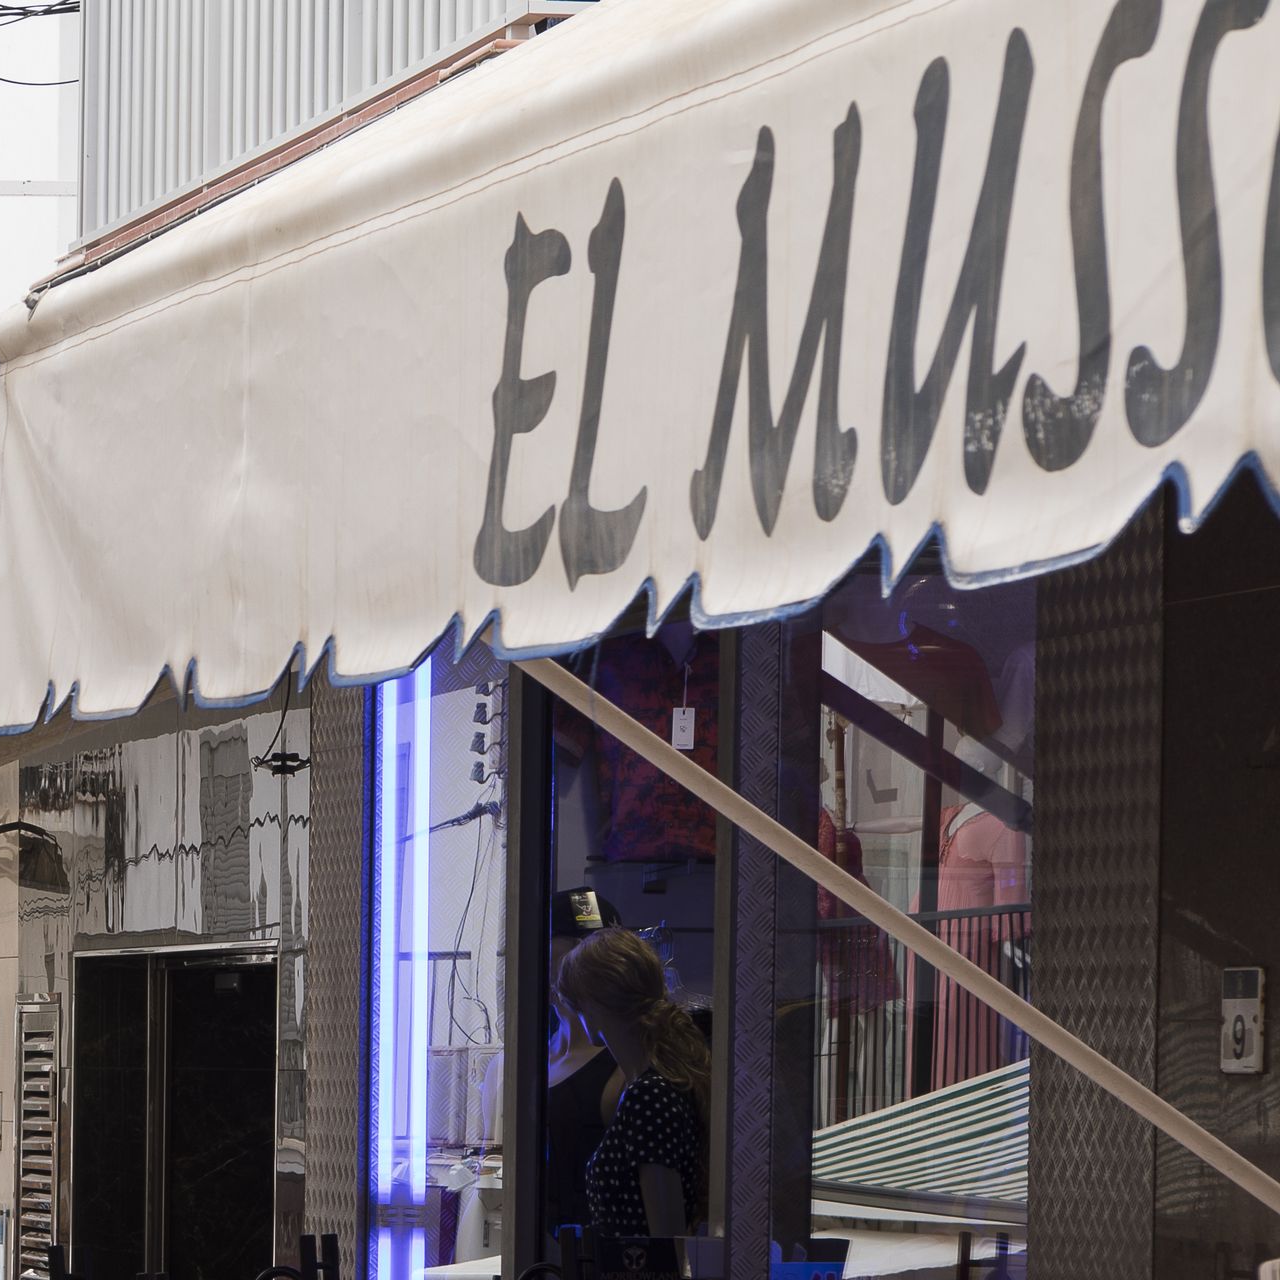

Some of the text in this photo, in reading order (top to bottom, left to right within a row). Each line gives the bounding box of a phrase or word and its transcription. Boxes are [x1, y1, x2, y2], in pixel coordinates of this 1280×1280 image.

[473, 0, 1280, 591] EL MUSS
[1232, 1014, 1246, 1060] 9
